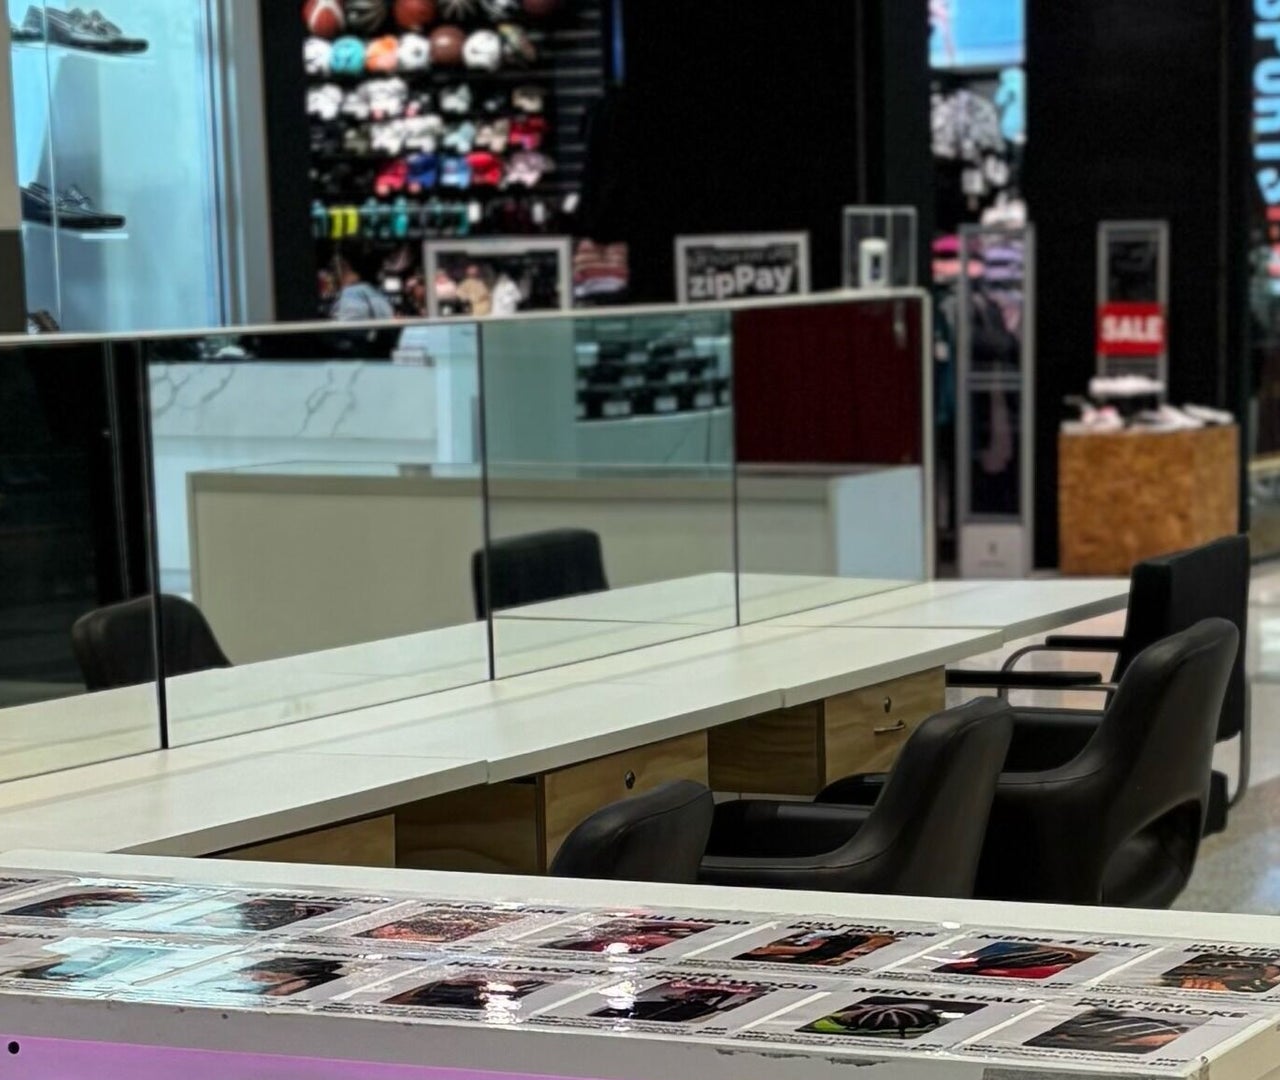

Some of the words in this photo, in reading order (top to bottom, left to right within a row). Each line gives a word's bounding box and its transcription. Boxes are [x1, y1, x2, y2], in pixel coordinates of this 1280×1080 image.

[689, 264, 794, 300] zipPay
[1101, 314, 1162, 343] SALE
[976, 934, 1054, 943] MENS
[1082, 940, 1151, 949] HALF
[447, 961, 616, 976] HOLLYWOOD
[644, 975, 818, 990] HOLLYWOOD
[852, 987, 935, 997] MENS
